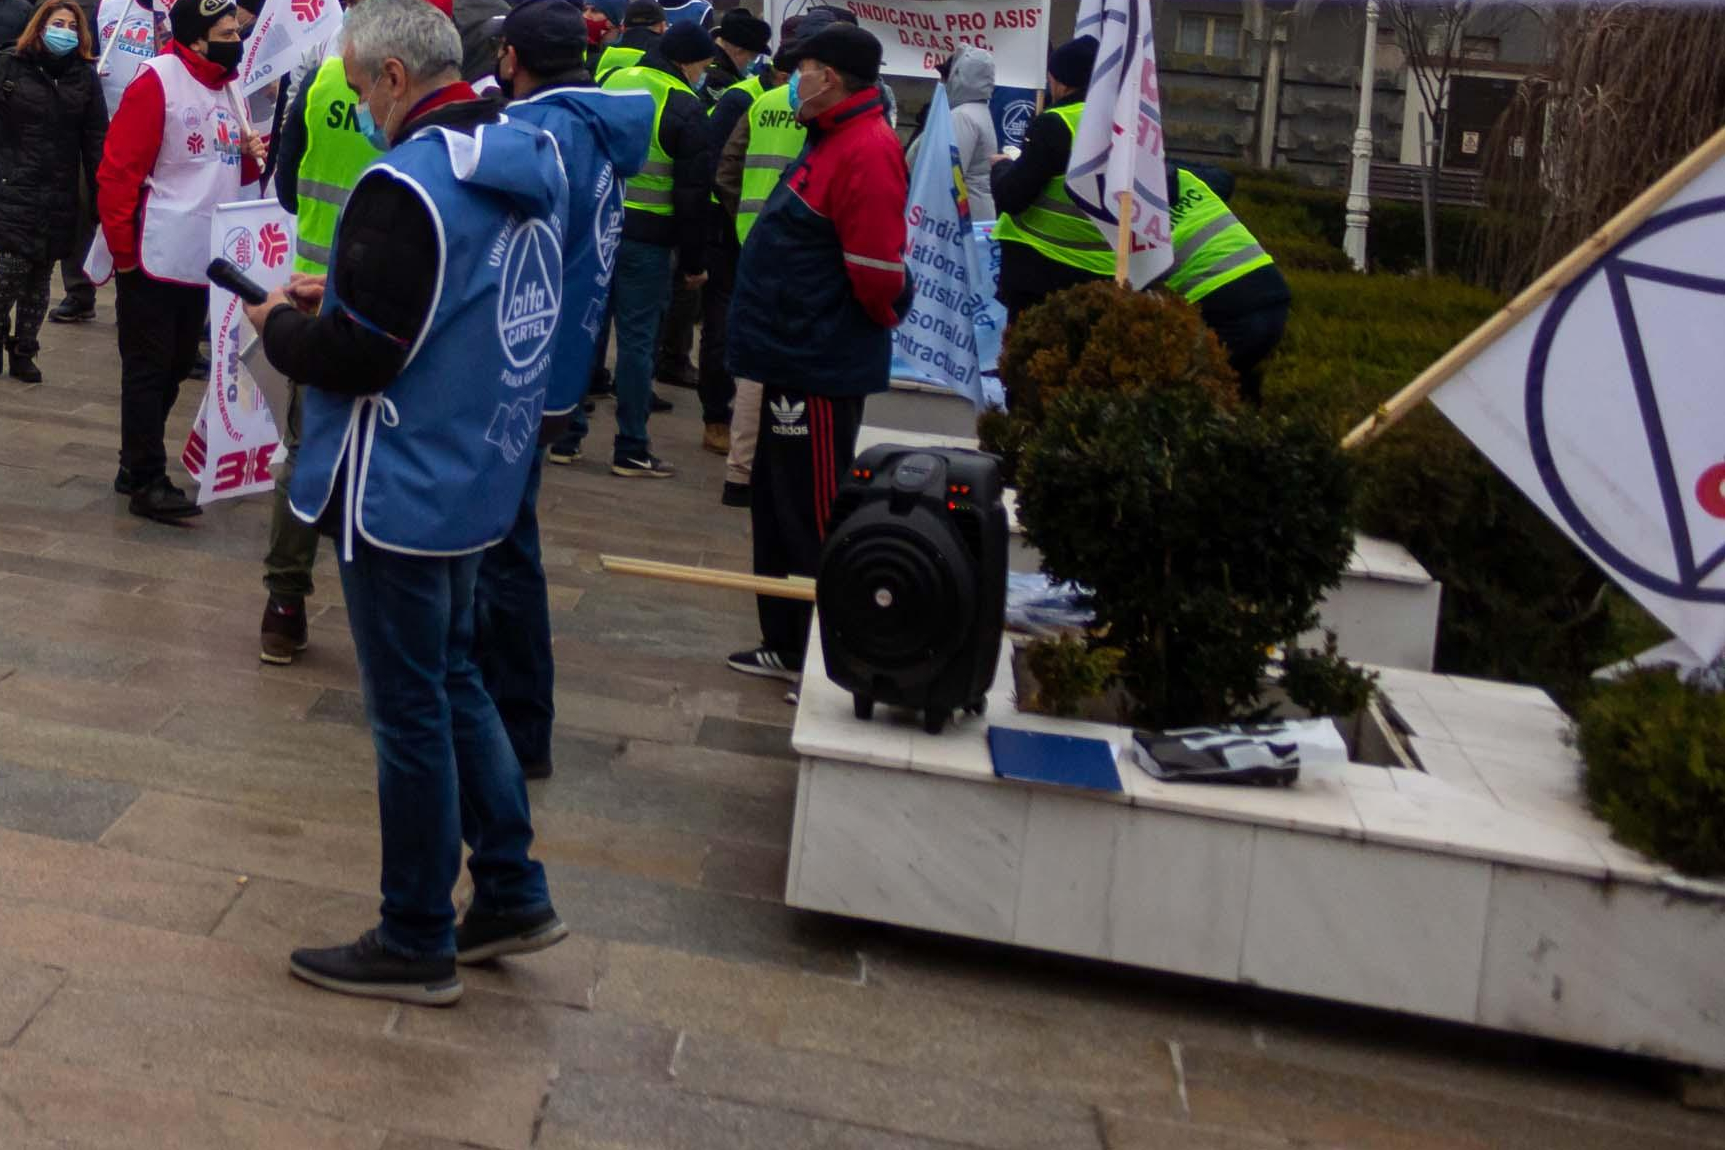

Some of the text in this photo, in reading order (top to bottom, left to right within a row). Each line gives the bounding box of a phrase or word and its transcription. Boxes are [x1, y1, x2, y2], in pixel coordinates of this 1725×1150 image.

[847, 0, 942, 32] SINDICATUL
[946, 10, 986, 32] PRO
[513, 281, 546, 318] alfa
[508, 319, 549, 348] CARTEL
[771, 424, 809, 436] adidas
